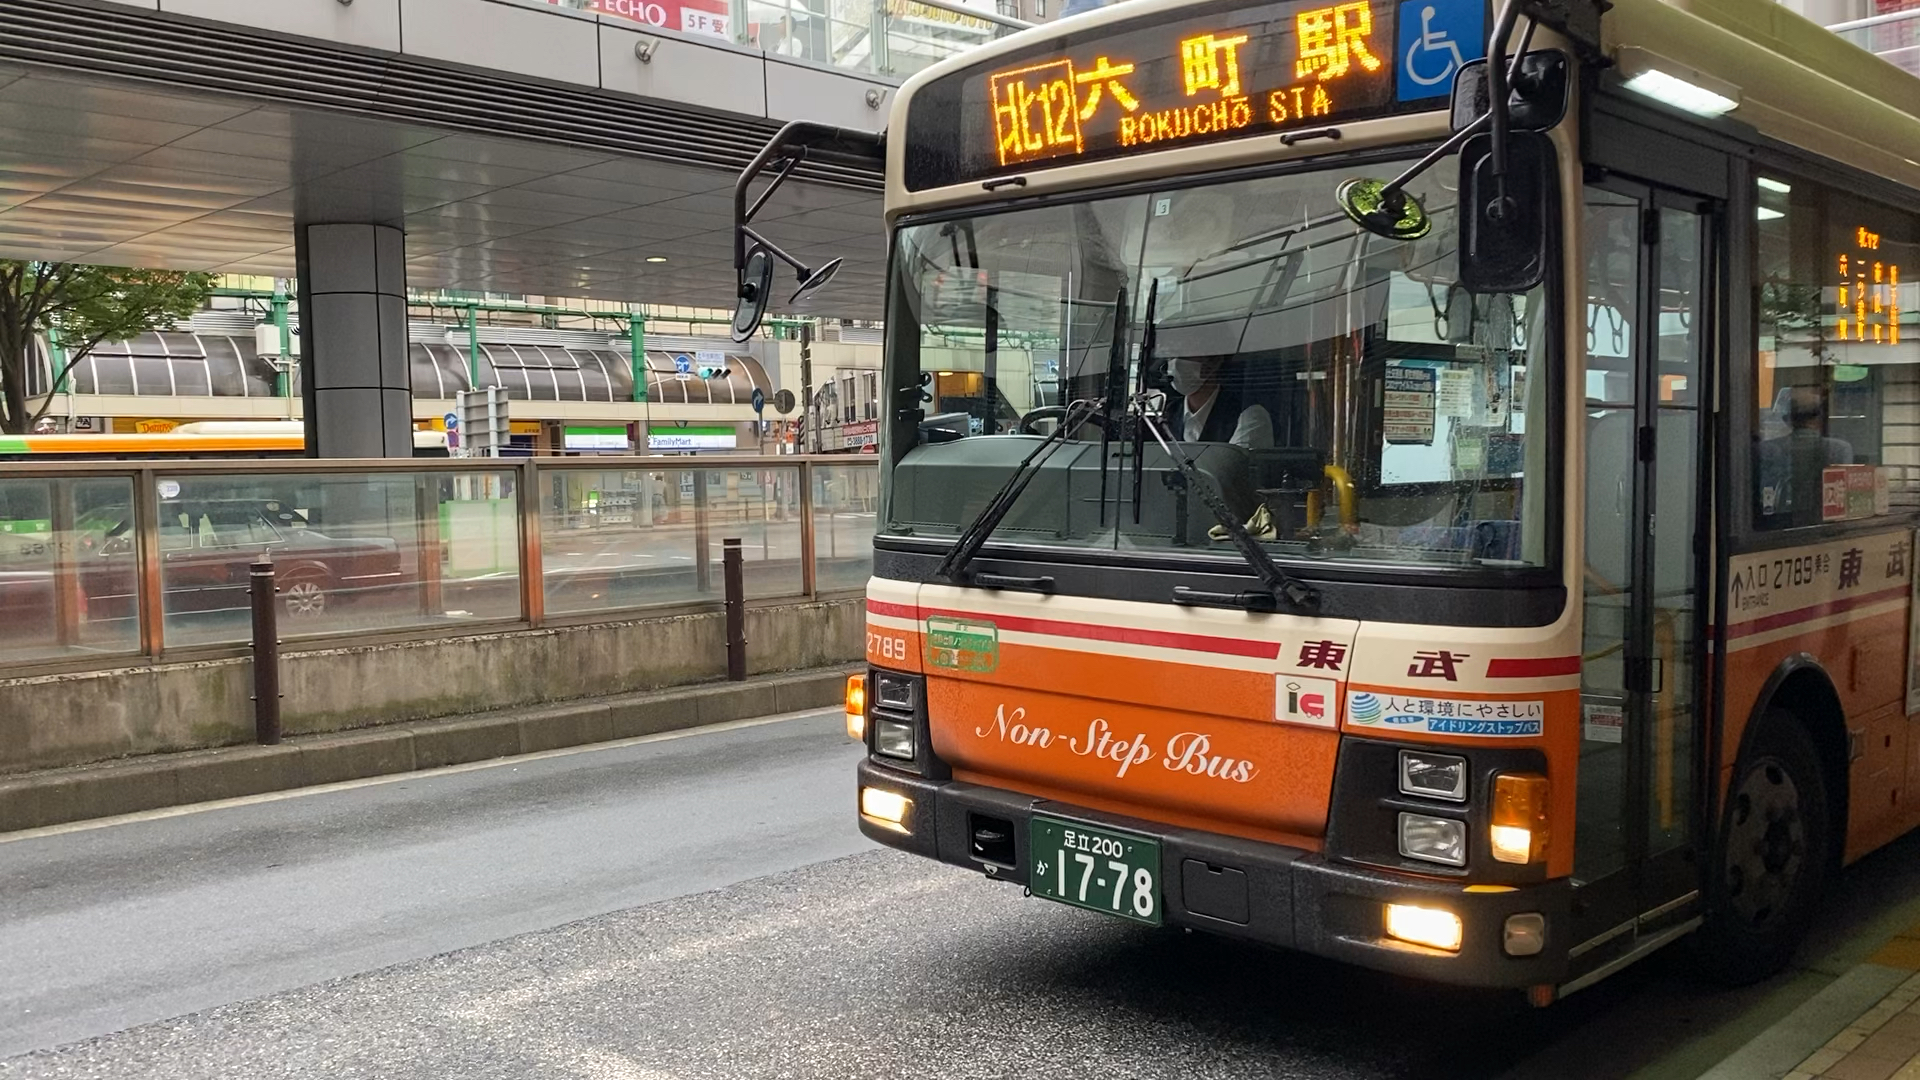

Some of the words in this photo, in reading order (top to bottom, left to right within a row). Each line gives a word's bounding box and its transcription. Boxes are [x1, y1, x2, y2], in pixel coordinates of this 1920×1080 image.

[604, 0, 667, 27] ECHO
[688, 14, 707, 29] 5F
[712, 19, 729, 34] 受
[998, 80, 1074, 155] 北12
[1270, 84, 1332, 123] STA
[653, 437, 692, 446] FamilyMart
[1746, 564, 1768, 591] 入口
[1774, 556, 1812, 589] 2789
[866, 631, 906, 661] 2789
[1385, 697, 1541, 718] 人と環境にやさしい
[975, 703, 1157, 778] Non-Step
[1163, 732, 1260, 783] Bus
[1036, 860, 1049, 876] か
[1058, 849, 1154, 917] 17-78
